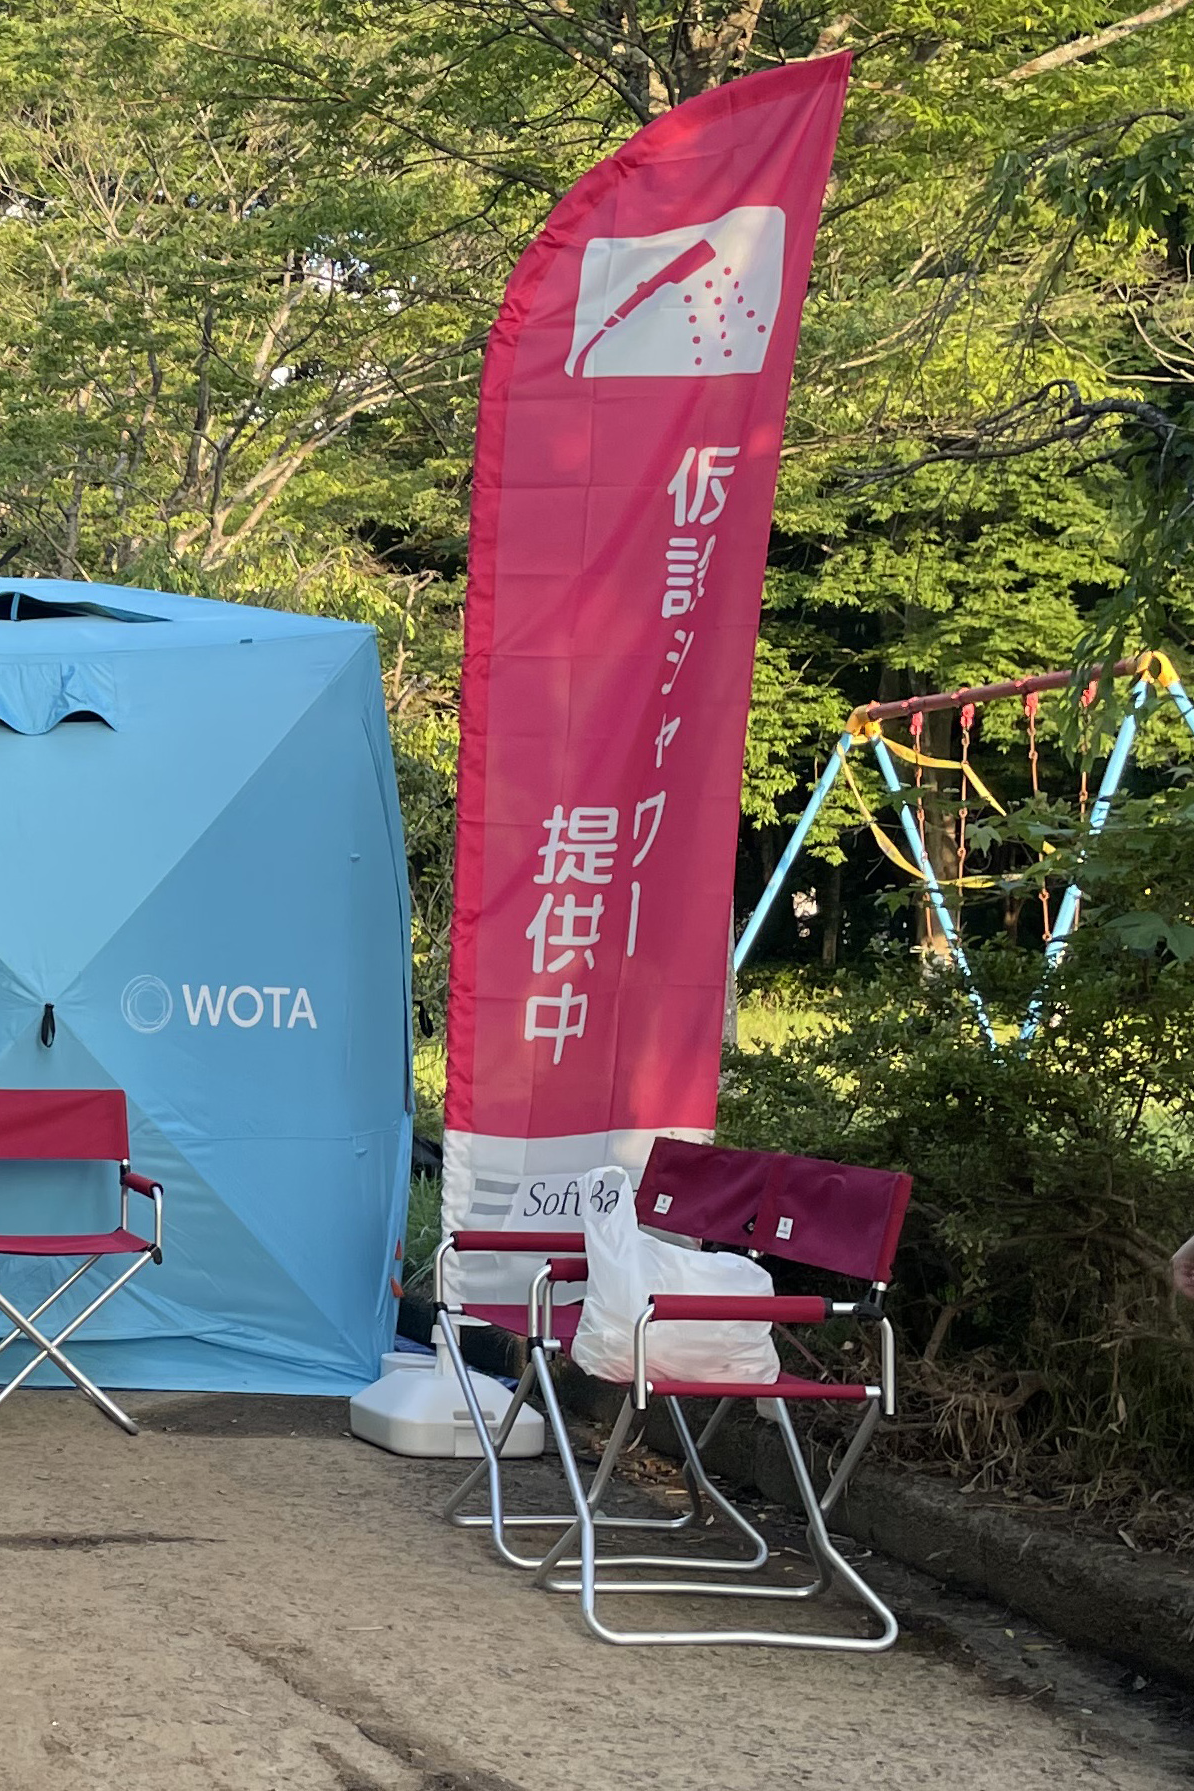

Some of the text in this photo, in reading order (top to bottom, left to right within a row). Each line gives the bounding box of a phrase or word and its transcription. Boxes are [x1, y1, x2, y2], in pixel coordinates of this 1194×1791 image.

[524, 805, 619, 1065] 提供中
[181, 984, 318, 1029] WOTA
[523, 1180, 638, 1216] SoftBa
